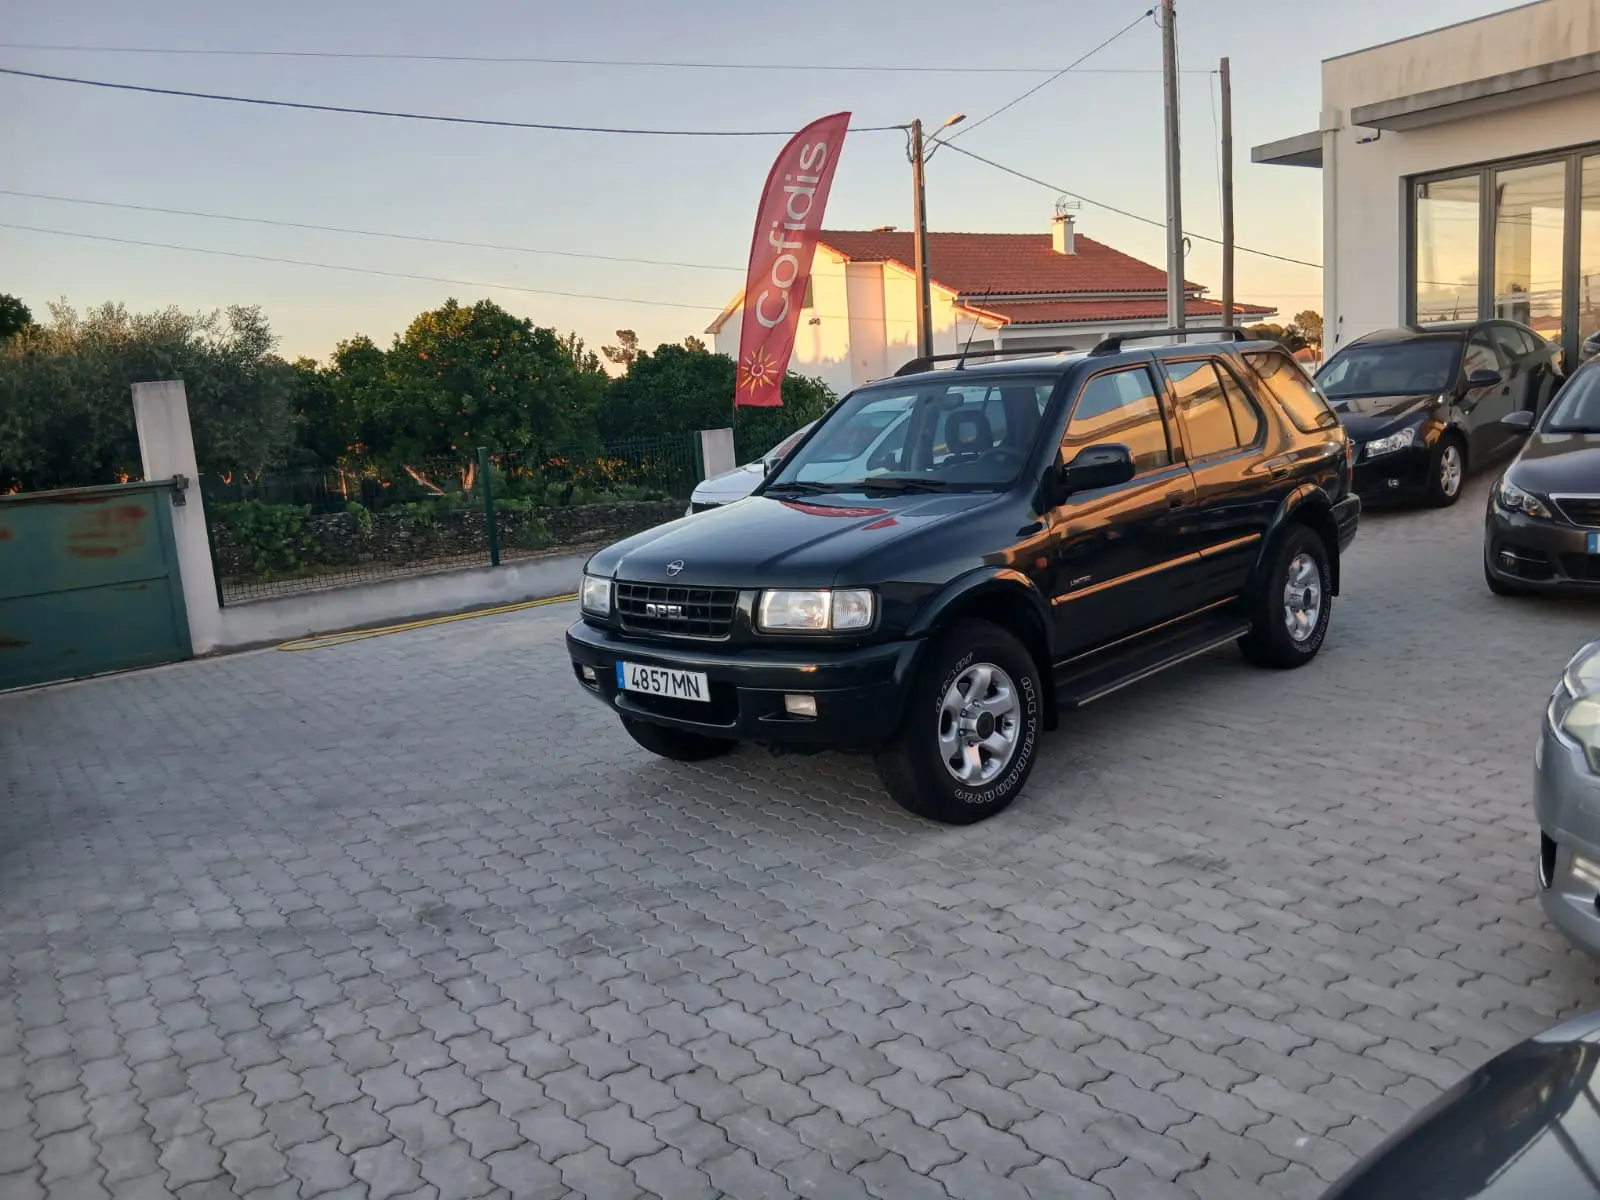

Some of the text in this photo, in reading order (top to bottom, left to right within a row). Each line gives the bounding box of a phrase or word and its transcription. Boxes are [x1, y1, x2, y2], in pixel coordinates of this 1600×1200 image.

[756, 142, 827, 328] Cofidis
[646, 603, 688, 620] OPEL
[632, 666, 701, 698] 4857MN
